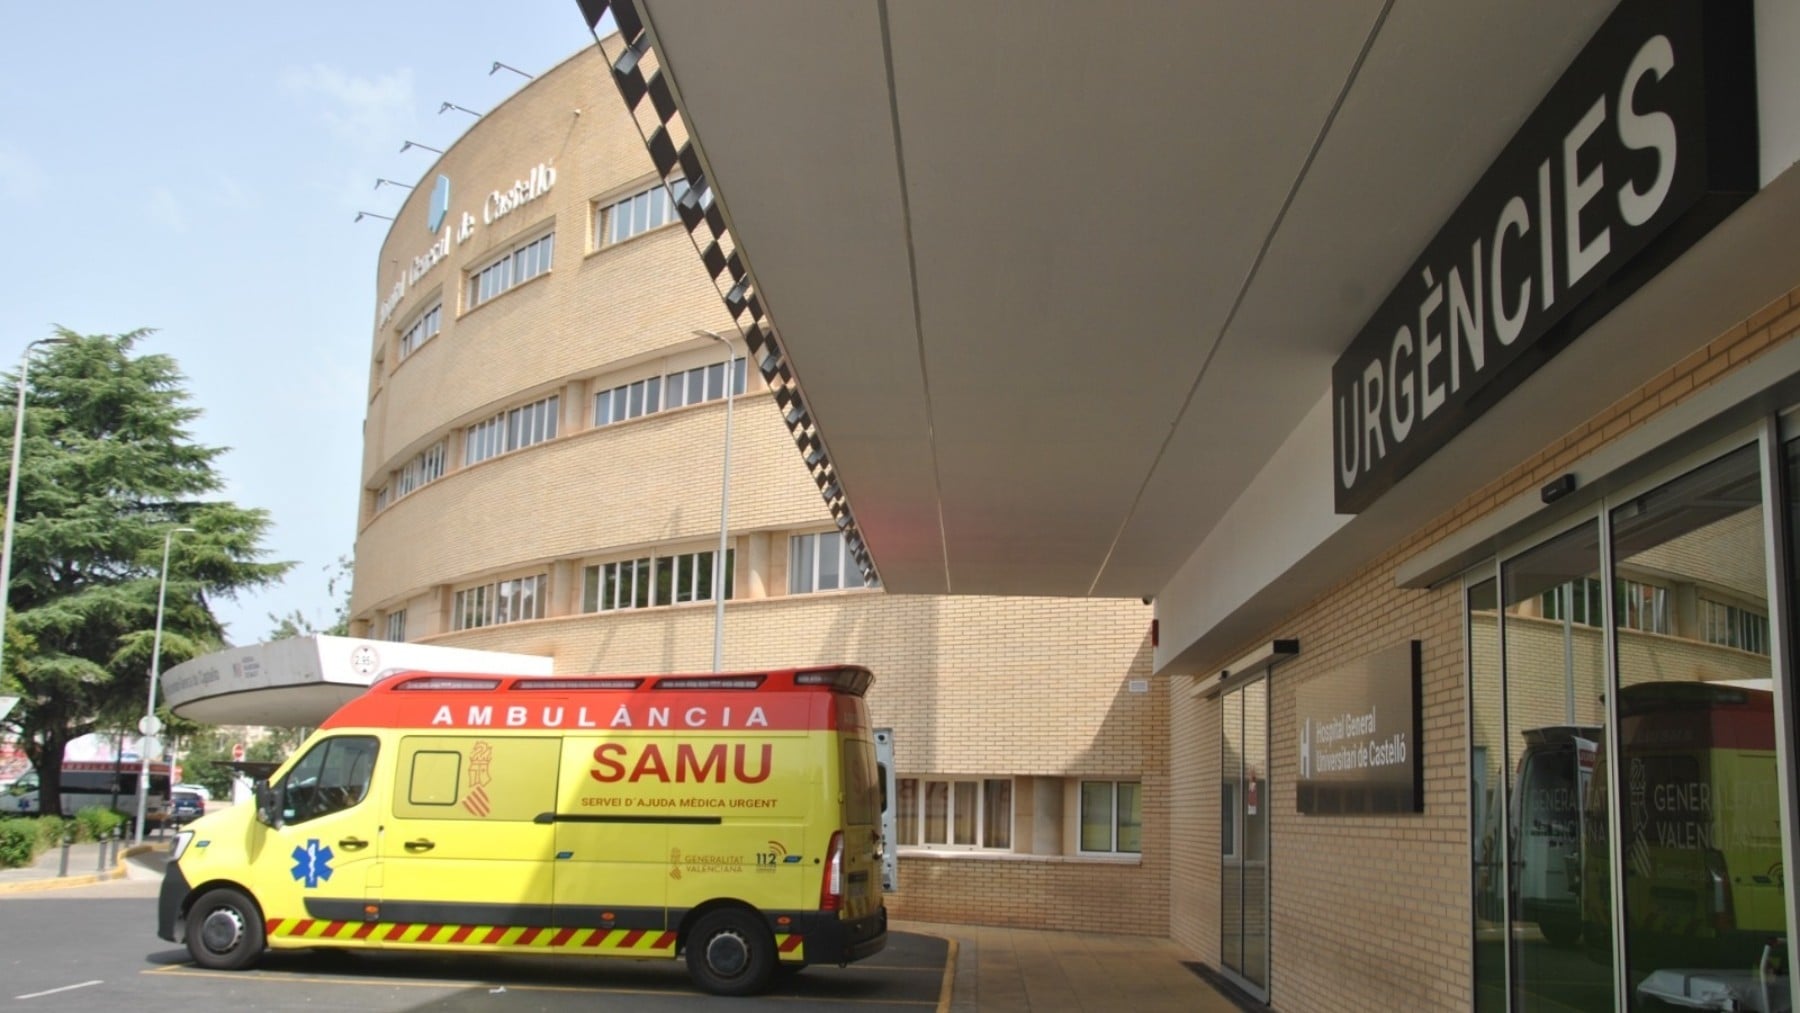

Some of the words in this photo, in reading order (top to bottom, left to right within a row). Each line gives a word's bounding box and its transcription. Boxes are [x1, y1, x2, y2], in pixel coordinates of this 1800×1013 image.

[456, 211, 476, 245] de
[483, 158, 556, 225] Castelló
[1340, 34, 1677, 489] URGÈNCIES
[432, 704, 769, 728] AMBULÀNCIA
[1316, 712, 1345, 746] Hospital
[1345, 705, 1376, 738] General
[590, 742, 773, 784] SAMU
[1316, 744, 1357, 773] Universitari
[1358, 745, 1368, 768] de
[1369, 732, 1406, 767] Castelló
[581, 797, 622, 807] SERVEI
[679, 796, 726, 808] MÈDICA
[729, 798, 777, 808] URGENT
[684, 855, 744, 865] GENERALITAT
[686, 865, 743, 873] VALENCIANA
[756, 853, 776, 865] 112
